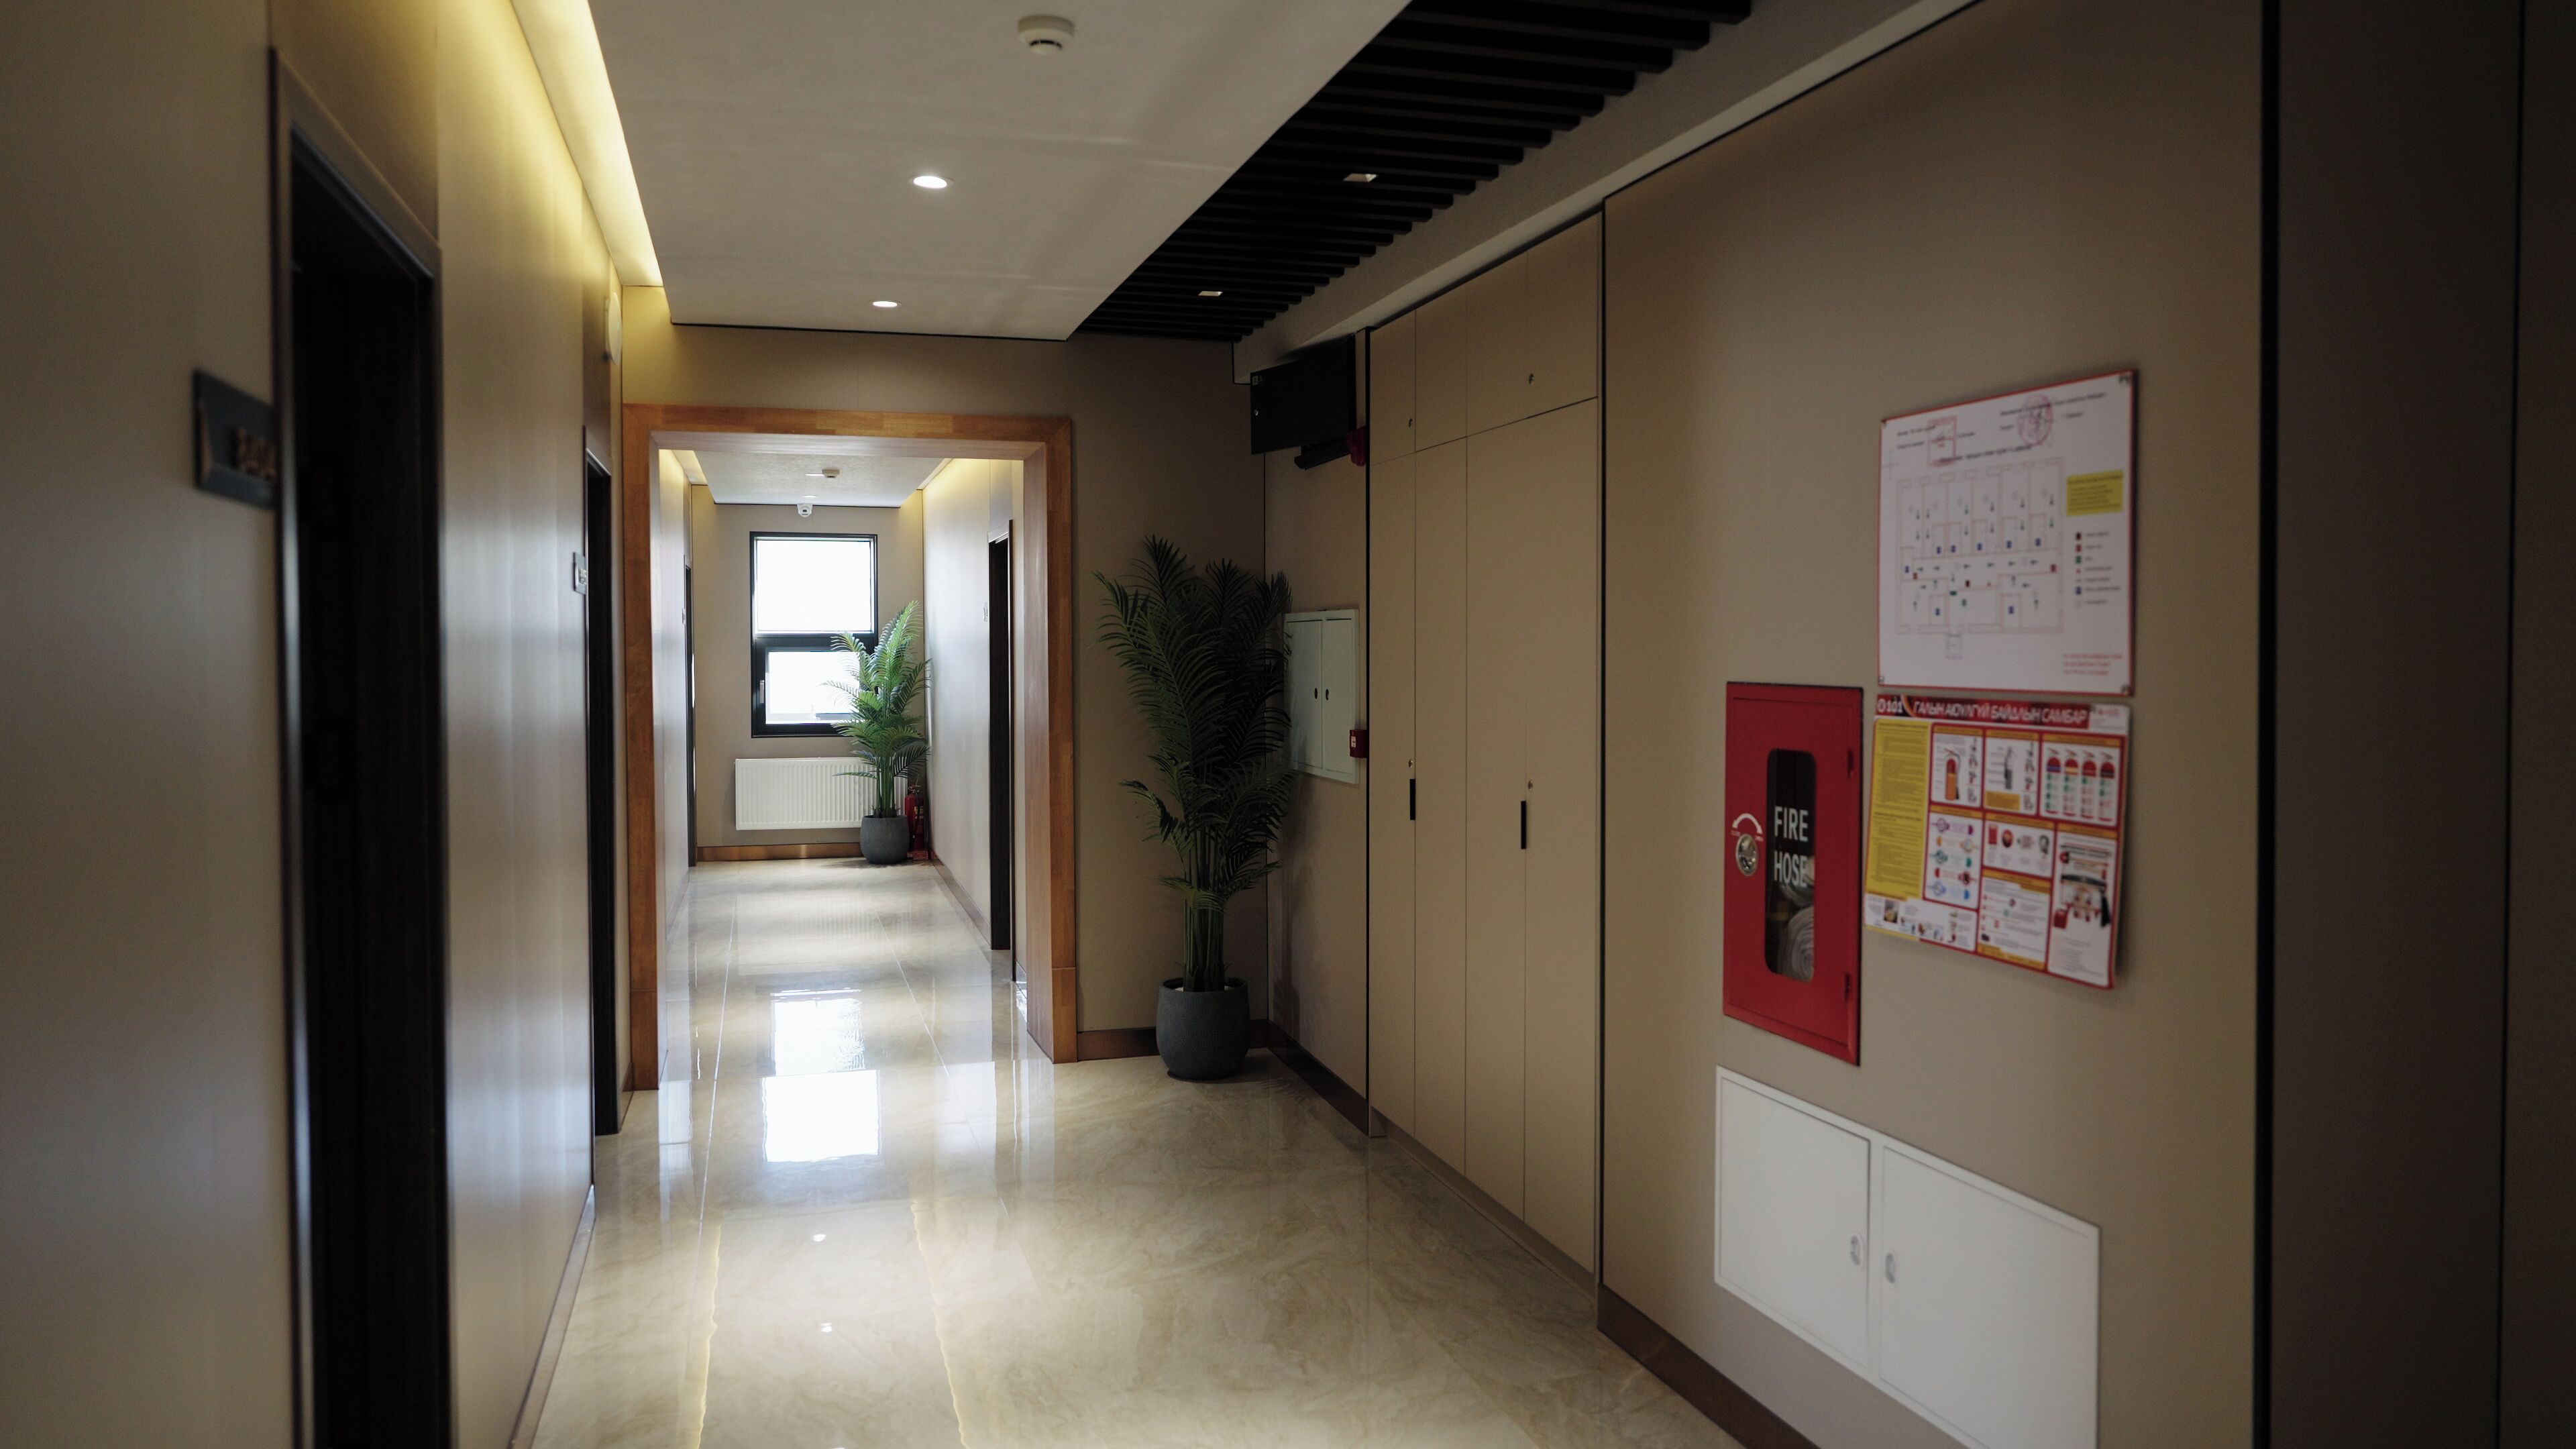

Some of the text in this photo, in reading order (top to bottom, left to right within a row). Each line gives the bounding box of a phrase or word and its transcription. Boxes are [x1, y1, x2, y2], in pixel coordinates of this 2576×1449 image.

[2041, 707, 2088, 725] САМБАР
[1774, 806, 1809, 841] FIRE
[1774, 851, 1808, 888] HOSE
